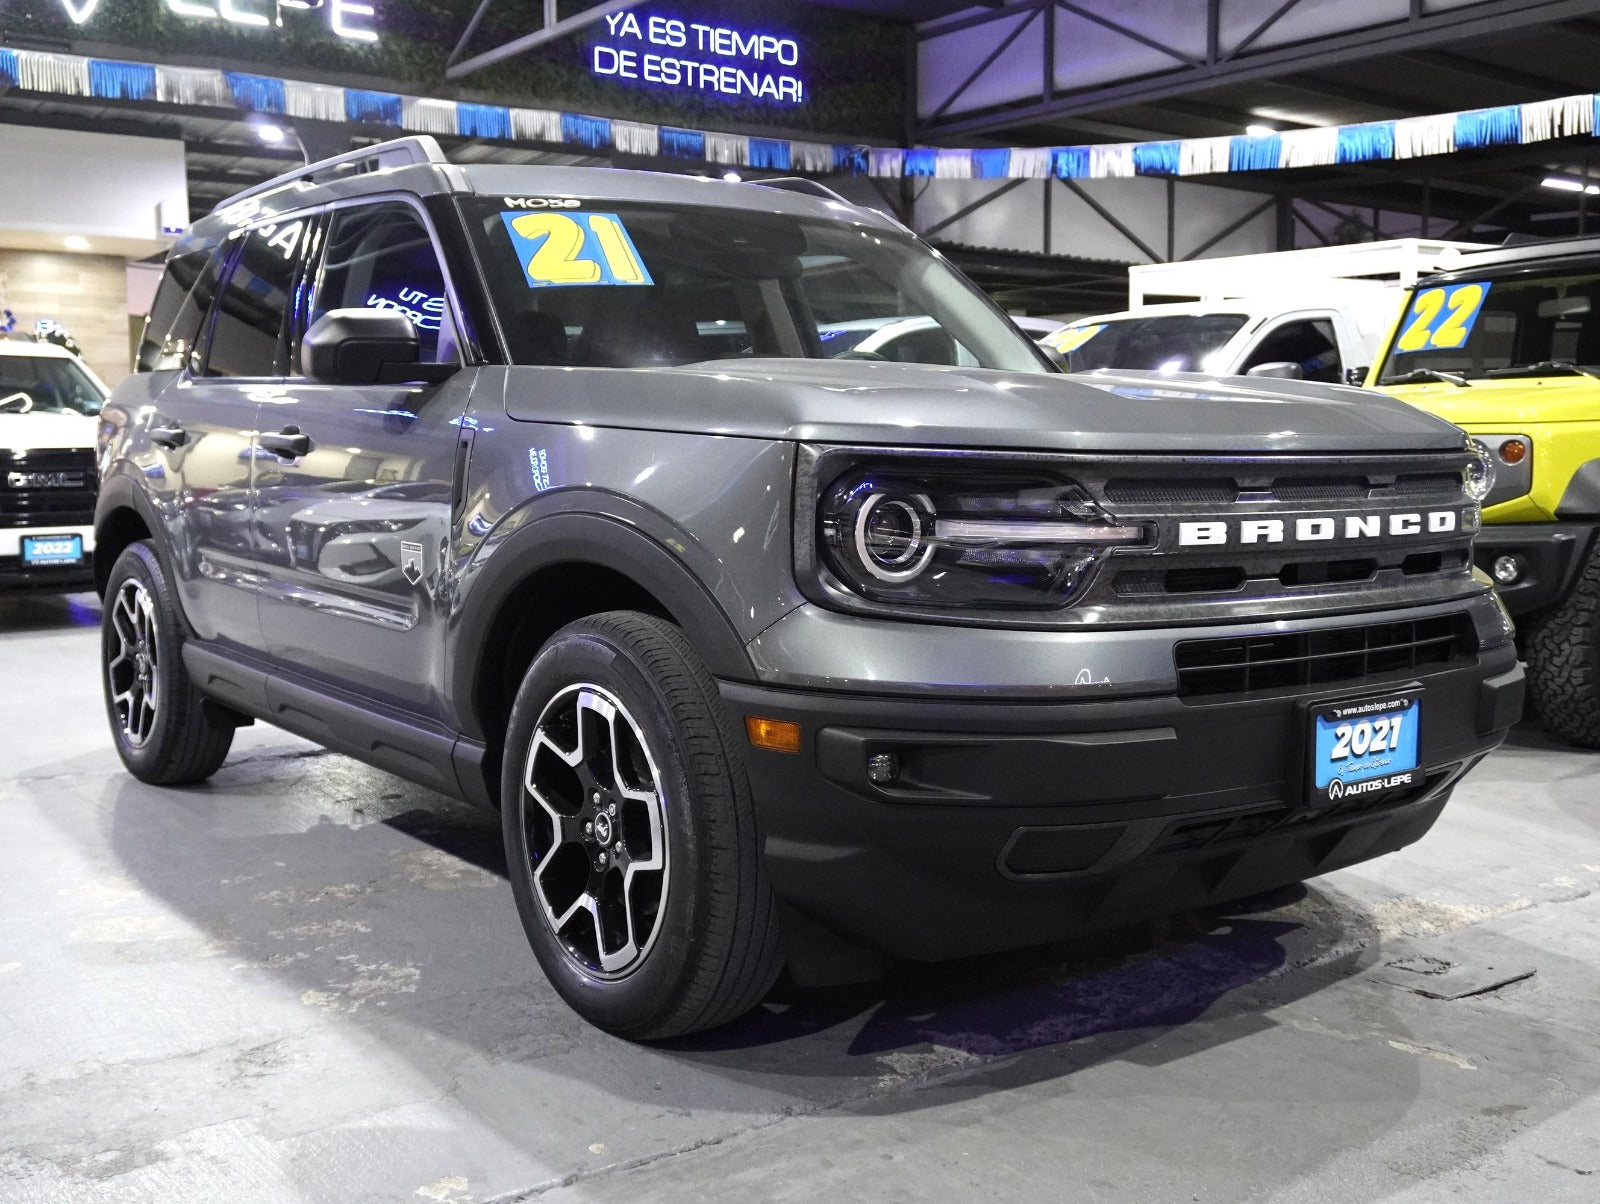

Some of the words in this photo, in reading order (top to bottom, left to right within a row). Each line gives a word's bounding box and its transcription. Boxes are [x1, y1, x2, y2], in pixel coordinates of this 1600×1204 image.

[605, 12, 642, 40] YA
[648, 16, 686, 48] ES
[690, 24, 798, 66] TIEMPO
[594, 45, 638, 79] DE
[643, 54, 803, 103] ESTRENAR!
[511, 212, 645, 283] 21
[1397, 284, 1482, 351] 22
[32, 541, 73, 557] 2022
[1179, 511, 1456, 546] BRONCO
[1342, 700, 1401, 717] www.autoslepe.com
[1330, 714, 1404, 761] 2021
